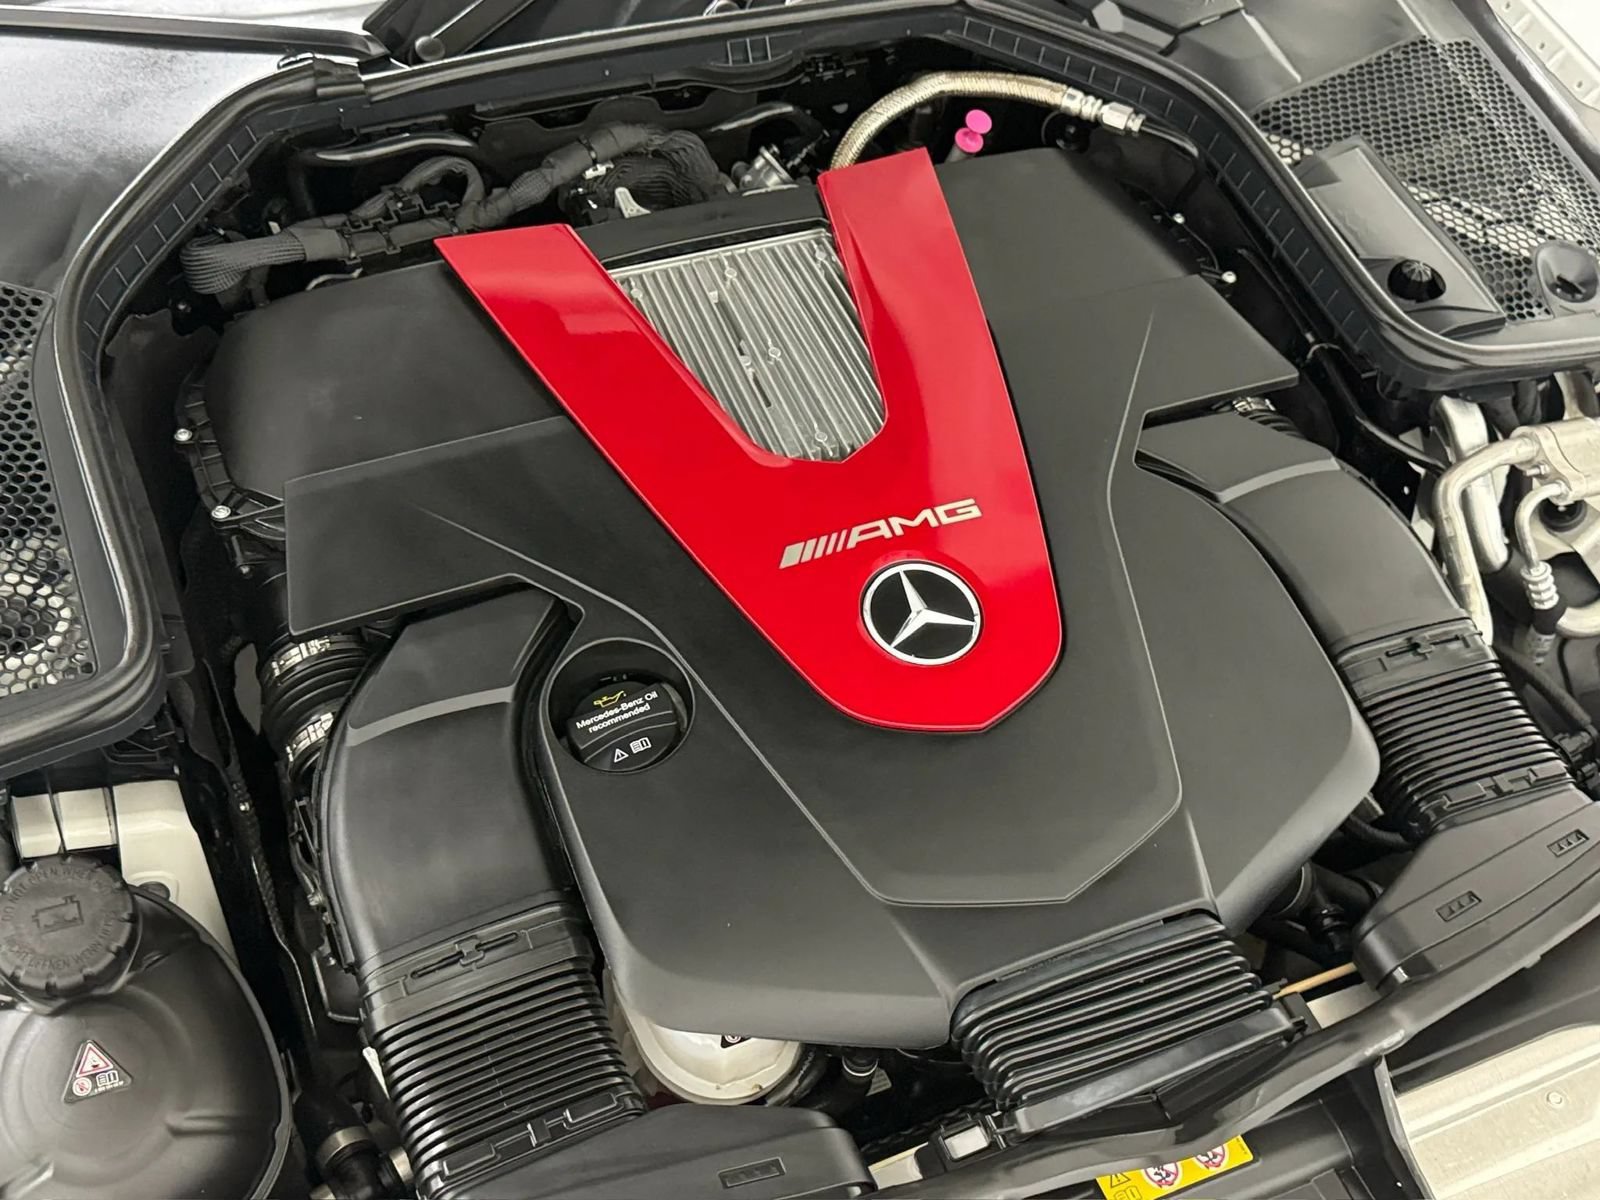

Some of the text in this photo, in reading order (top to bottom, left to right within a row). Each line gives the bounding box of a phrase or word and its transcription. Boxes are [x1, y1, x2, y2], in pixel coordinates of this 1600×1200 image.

[847, 498, 983, 549] AMG
[576, 690, 658, 729] Mercedes-Benz Oil
[588, 703, 650, 733] recommended
[8, 882, 28, 904] NOT
